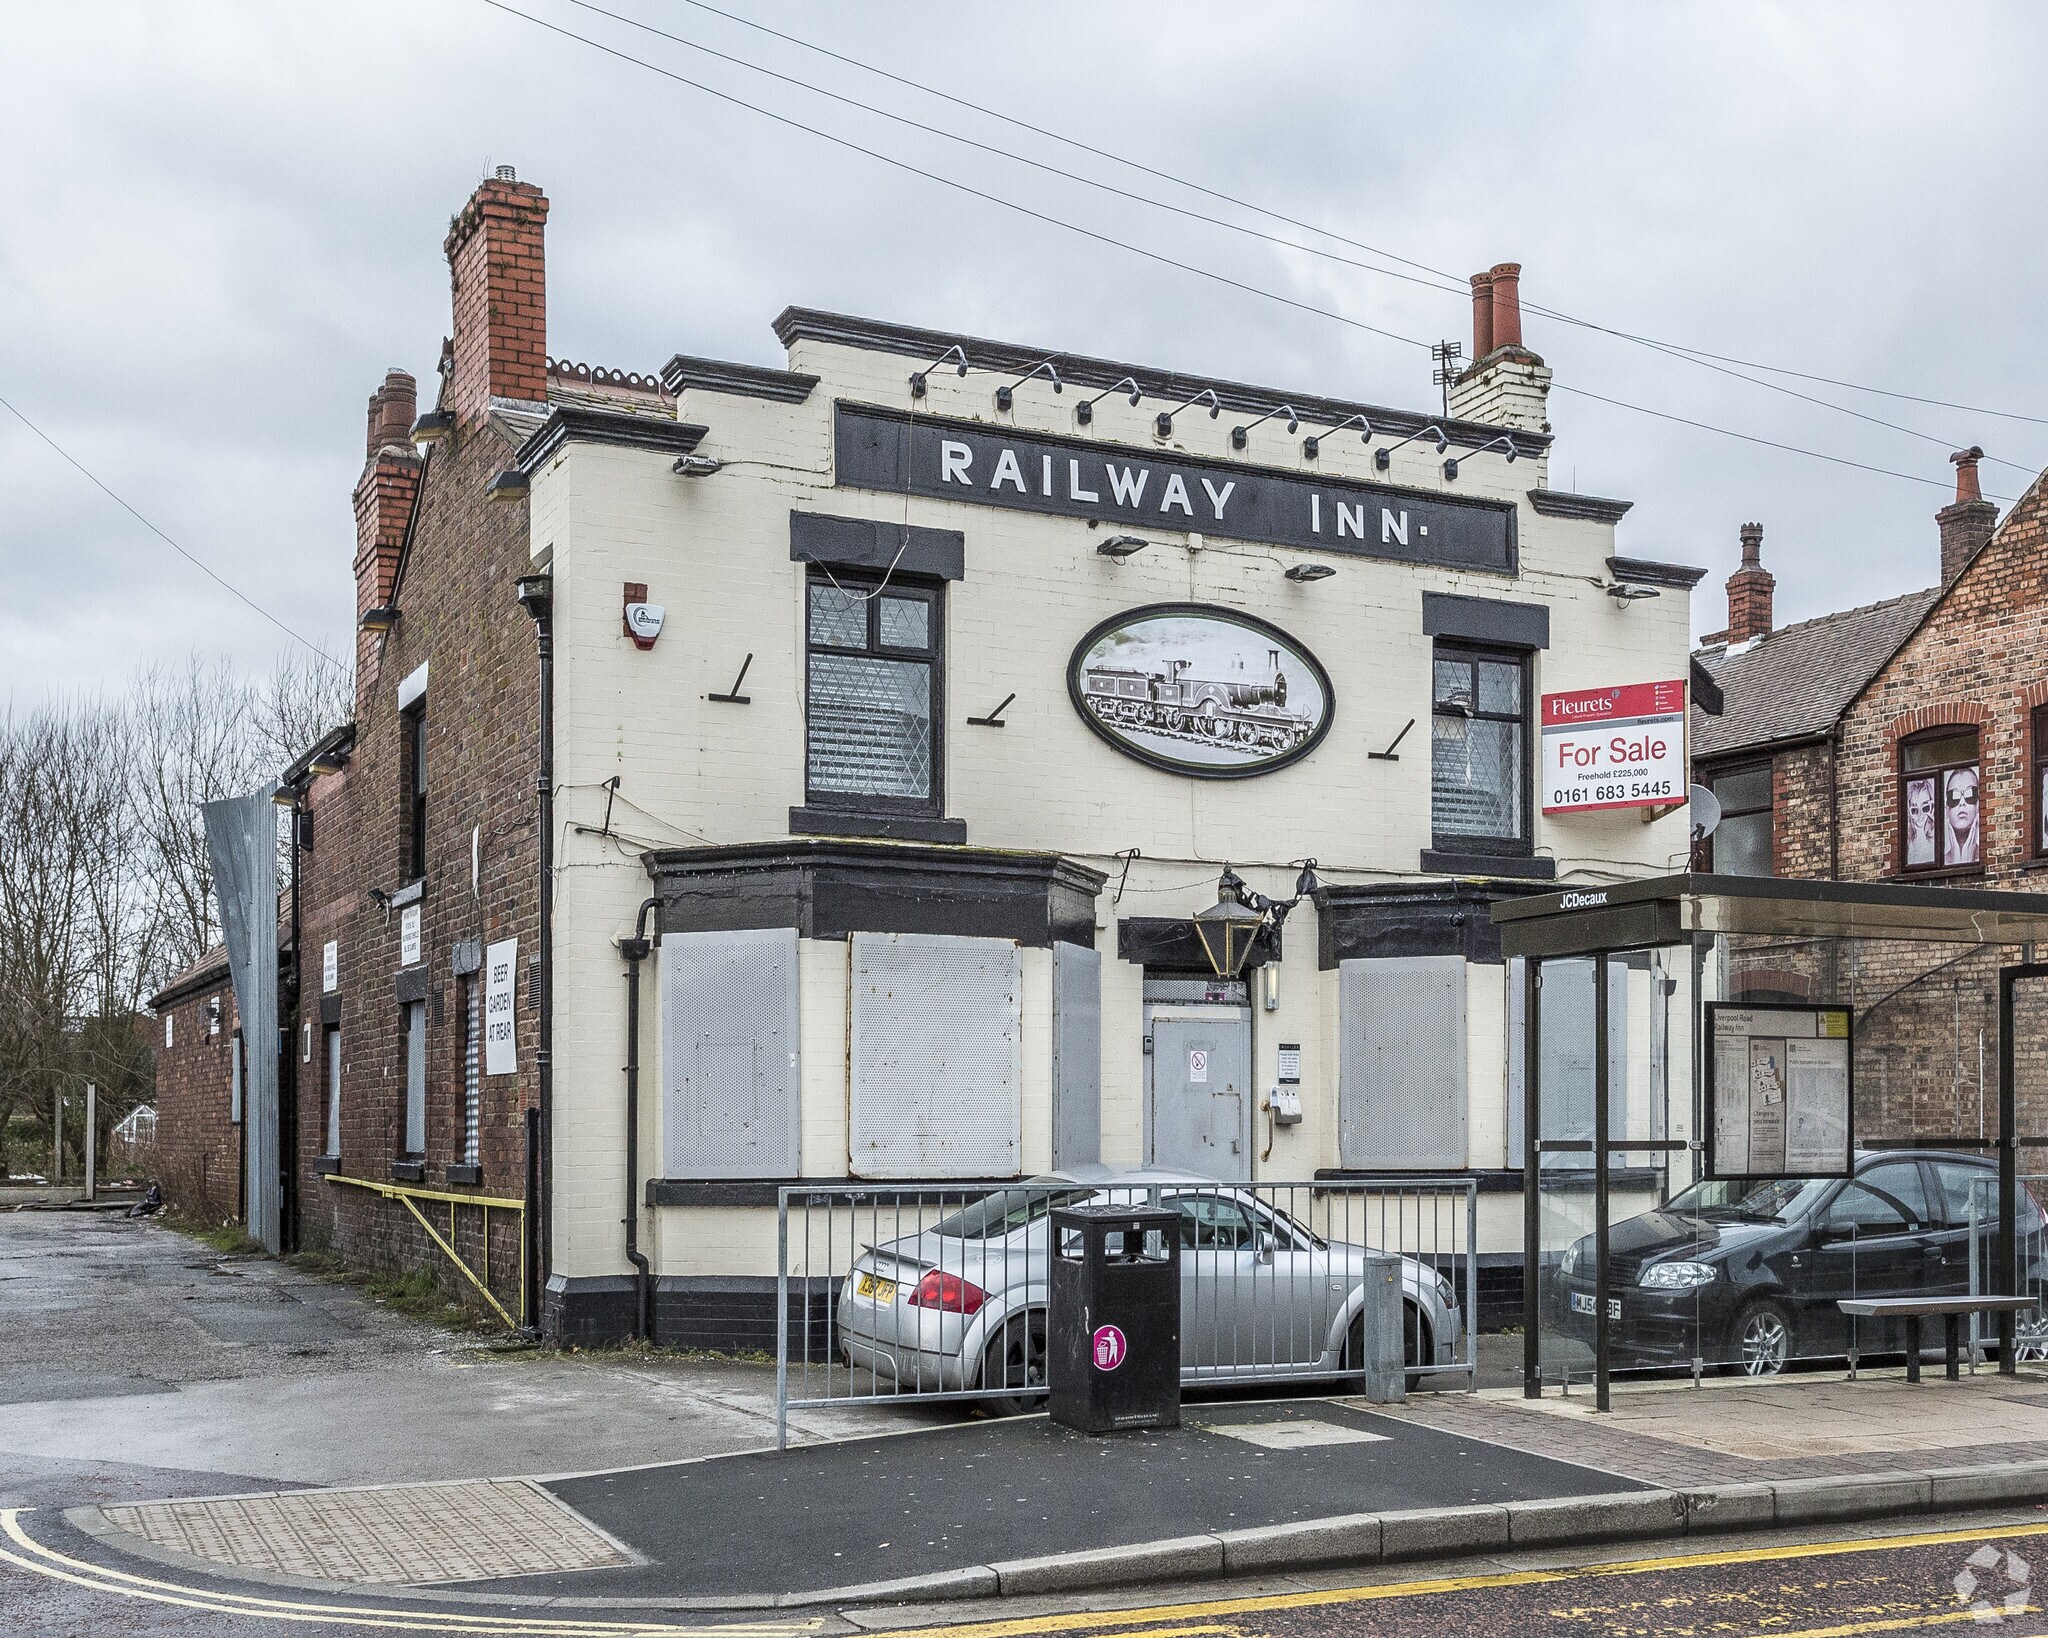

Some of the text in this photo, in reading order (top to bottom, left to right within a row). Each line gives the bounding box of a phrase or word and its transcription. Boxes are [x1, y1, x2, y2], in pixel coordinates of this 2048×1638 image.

[942, 440, 1236, 520] RAILWAY
[1552, 698, 1612, 716] Fleurets
[1637, 717, 1674, 725] fleurets.com
[1559, 735, 1667, 768] For Sale
[1577, 768, 1648, 781] Freehold £225,000
[1554, 780, 1671, 804] 0161 683 5445
[1560, 892, 1608, 909] JCDecaux
[494, 963, 508, 984] BEER
[489, 991, 511, 1014] GARDEN
[489, 1021, 512, 1042] AT REAR
